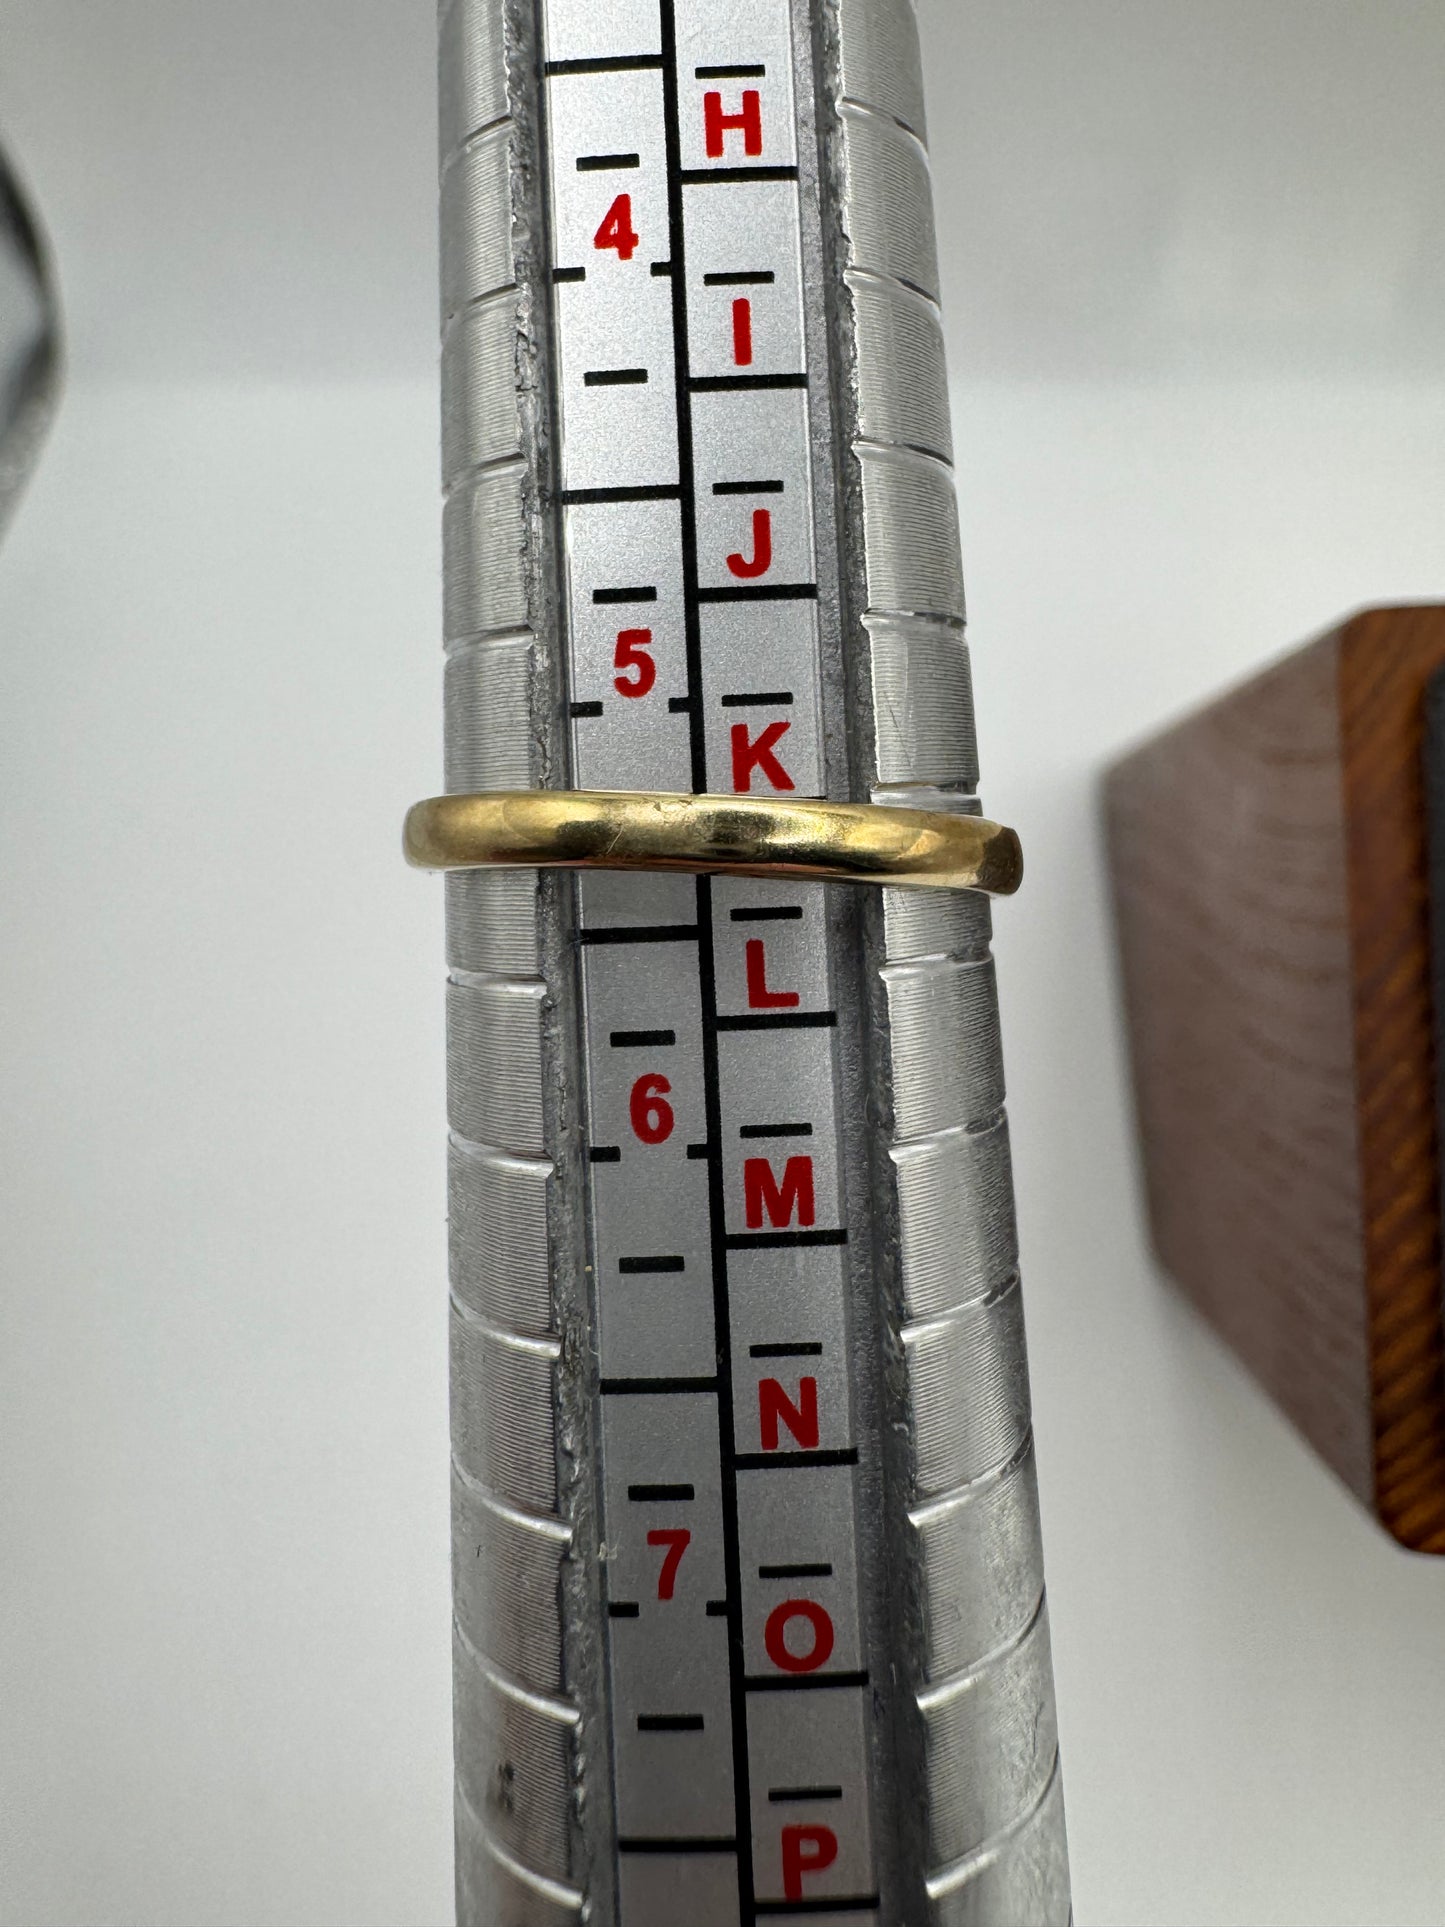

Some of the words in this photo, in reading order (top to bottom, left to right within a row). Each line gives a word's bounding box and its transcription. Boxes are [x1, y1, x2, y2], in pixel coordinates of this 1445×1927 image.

[703, 90, 763, 158] H
[593, 193, 639, 261] 4
[731, 297, 752, 366] I
[726, 509, 772, 579] J
[614, 628, 657, 698] 5
[730, 721, 795, 795] K
[746, 940, 799, 1008] L
[630, 1073, 674, 1144] 6
[744, 1156, 815, 1229] M
[759, 1377, 819, 1450] N
[648, 1530, 690, 1599] 7
[765, 1600, 834, 1674] O
[782, 1825, 838, 1900] P
